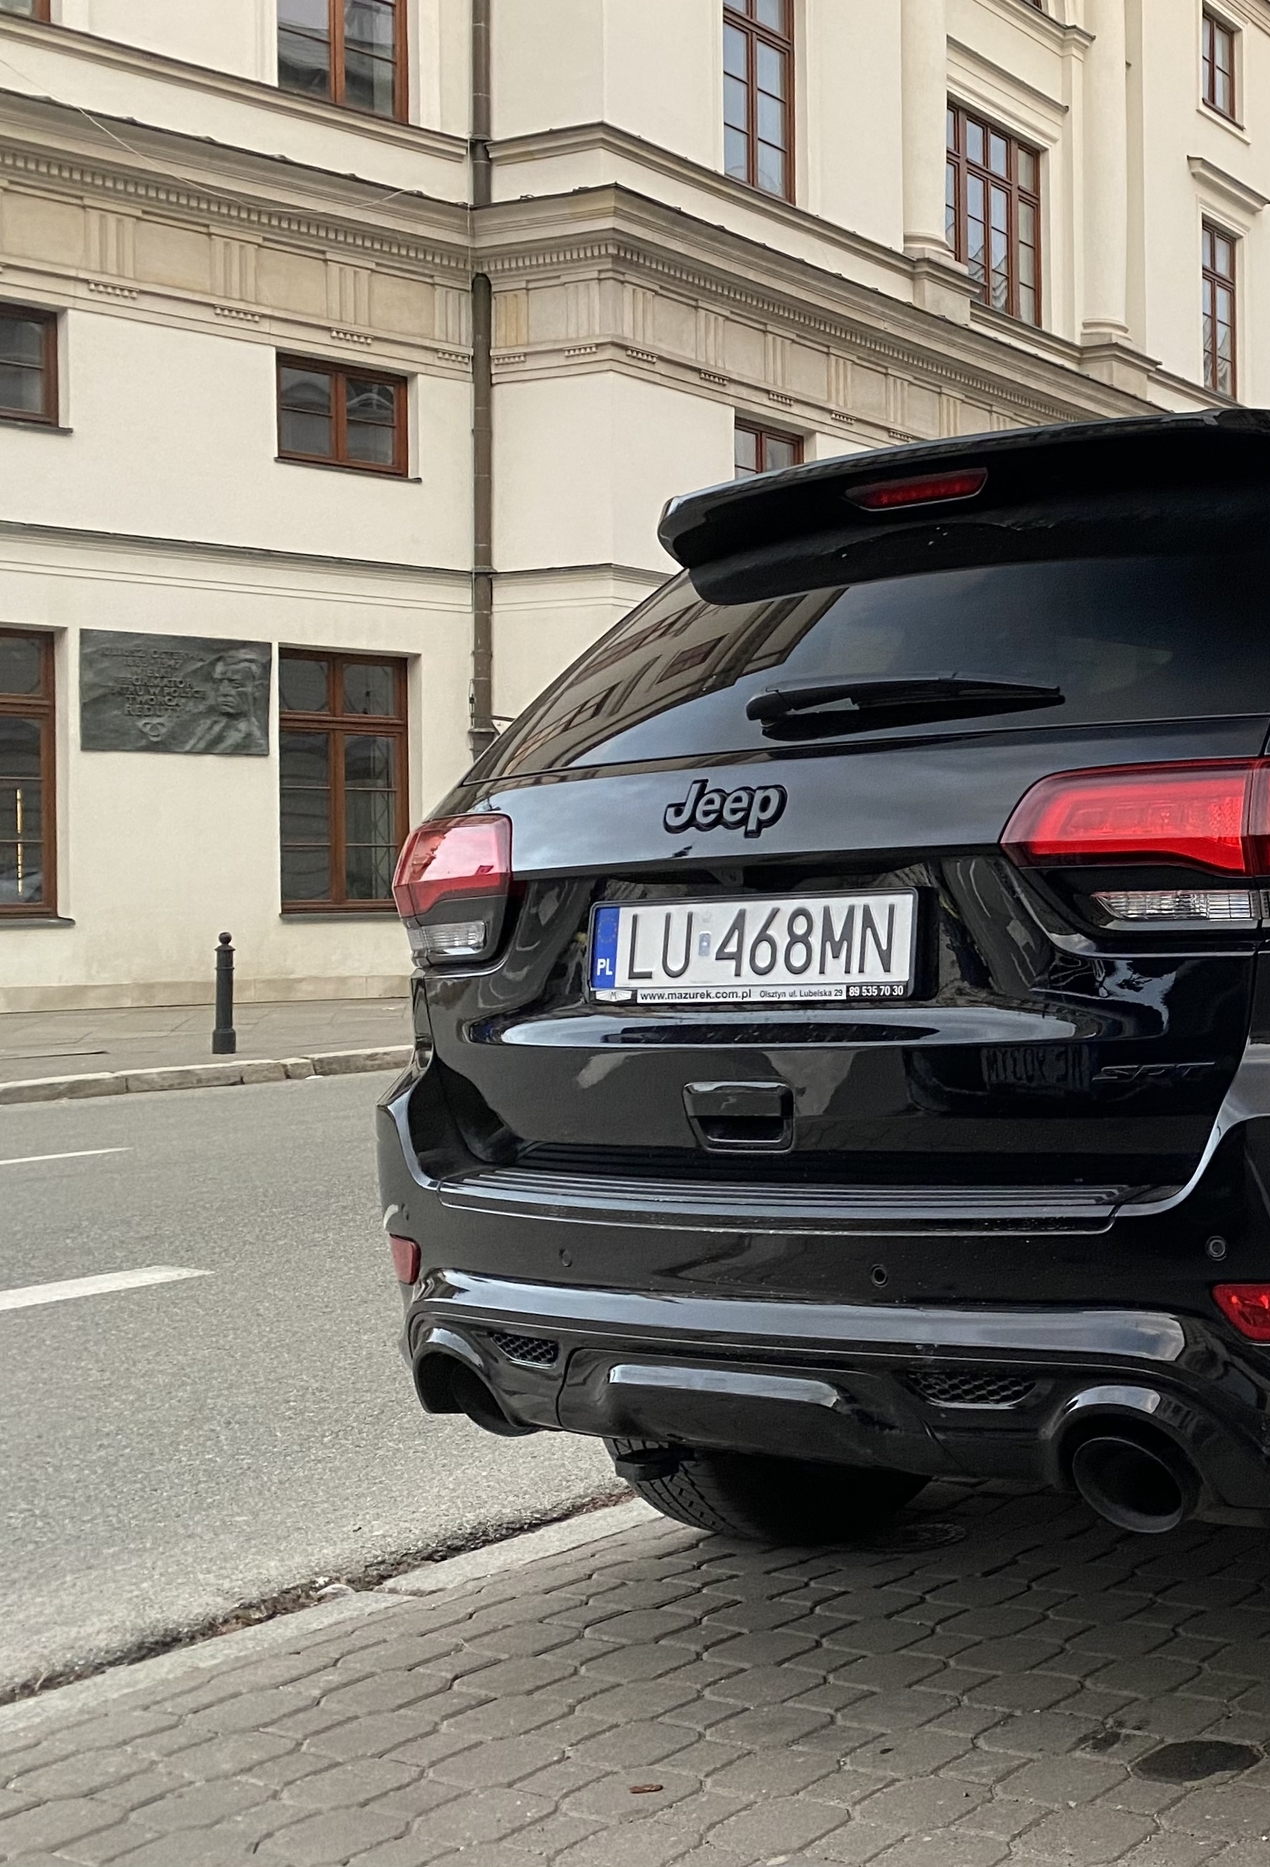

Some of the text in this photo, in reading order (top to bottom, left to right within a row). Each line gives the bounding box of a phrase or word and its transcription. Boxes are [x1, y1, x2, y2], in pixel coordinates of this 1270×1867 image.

[663, 778, 787, 838] Jeep
[628, 903, 896, 979] LU 468MN
[597, 958, 613, 976] PL
[640, 985, 904, 1001] www.mazurek.com.pl Olsztyn ul. Lubelska 29 89 535 70 30
